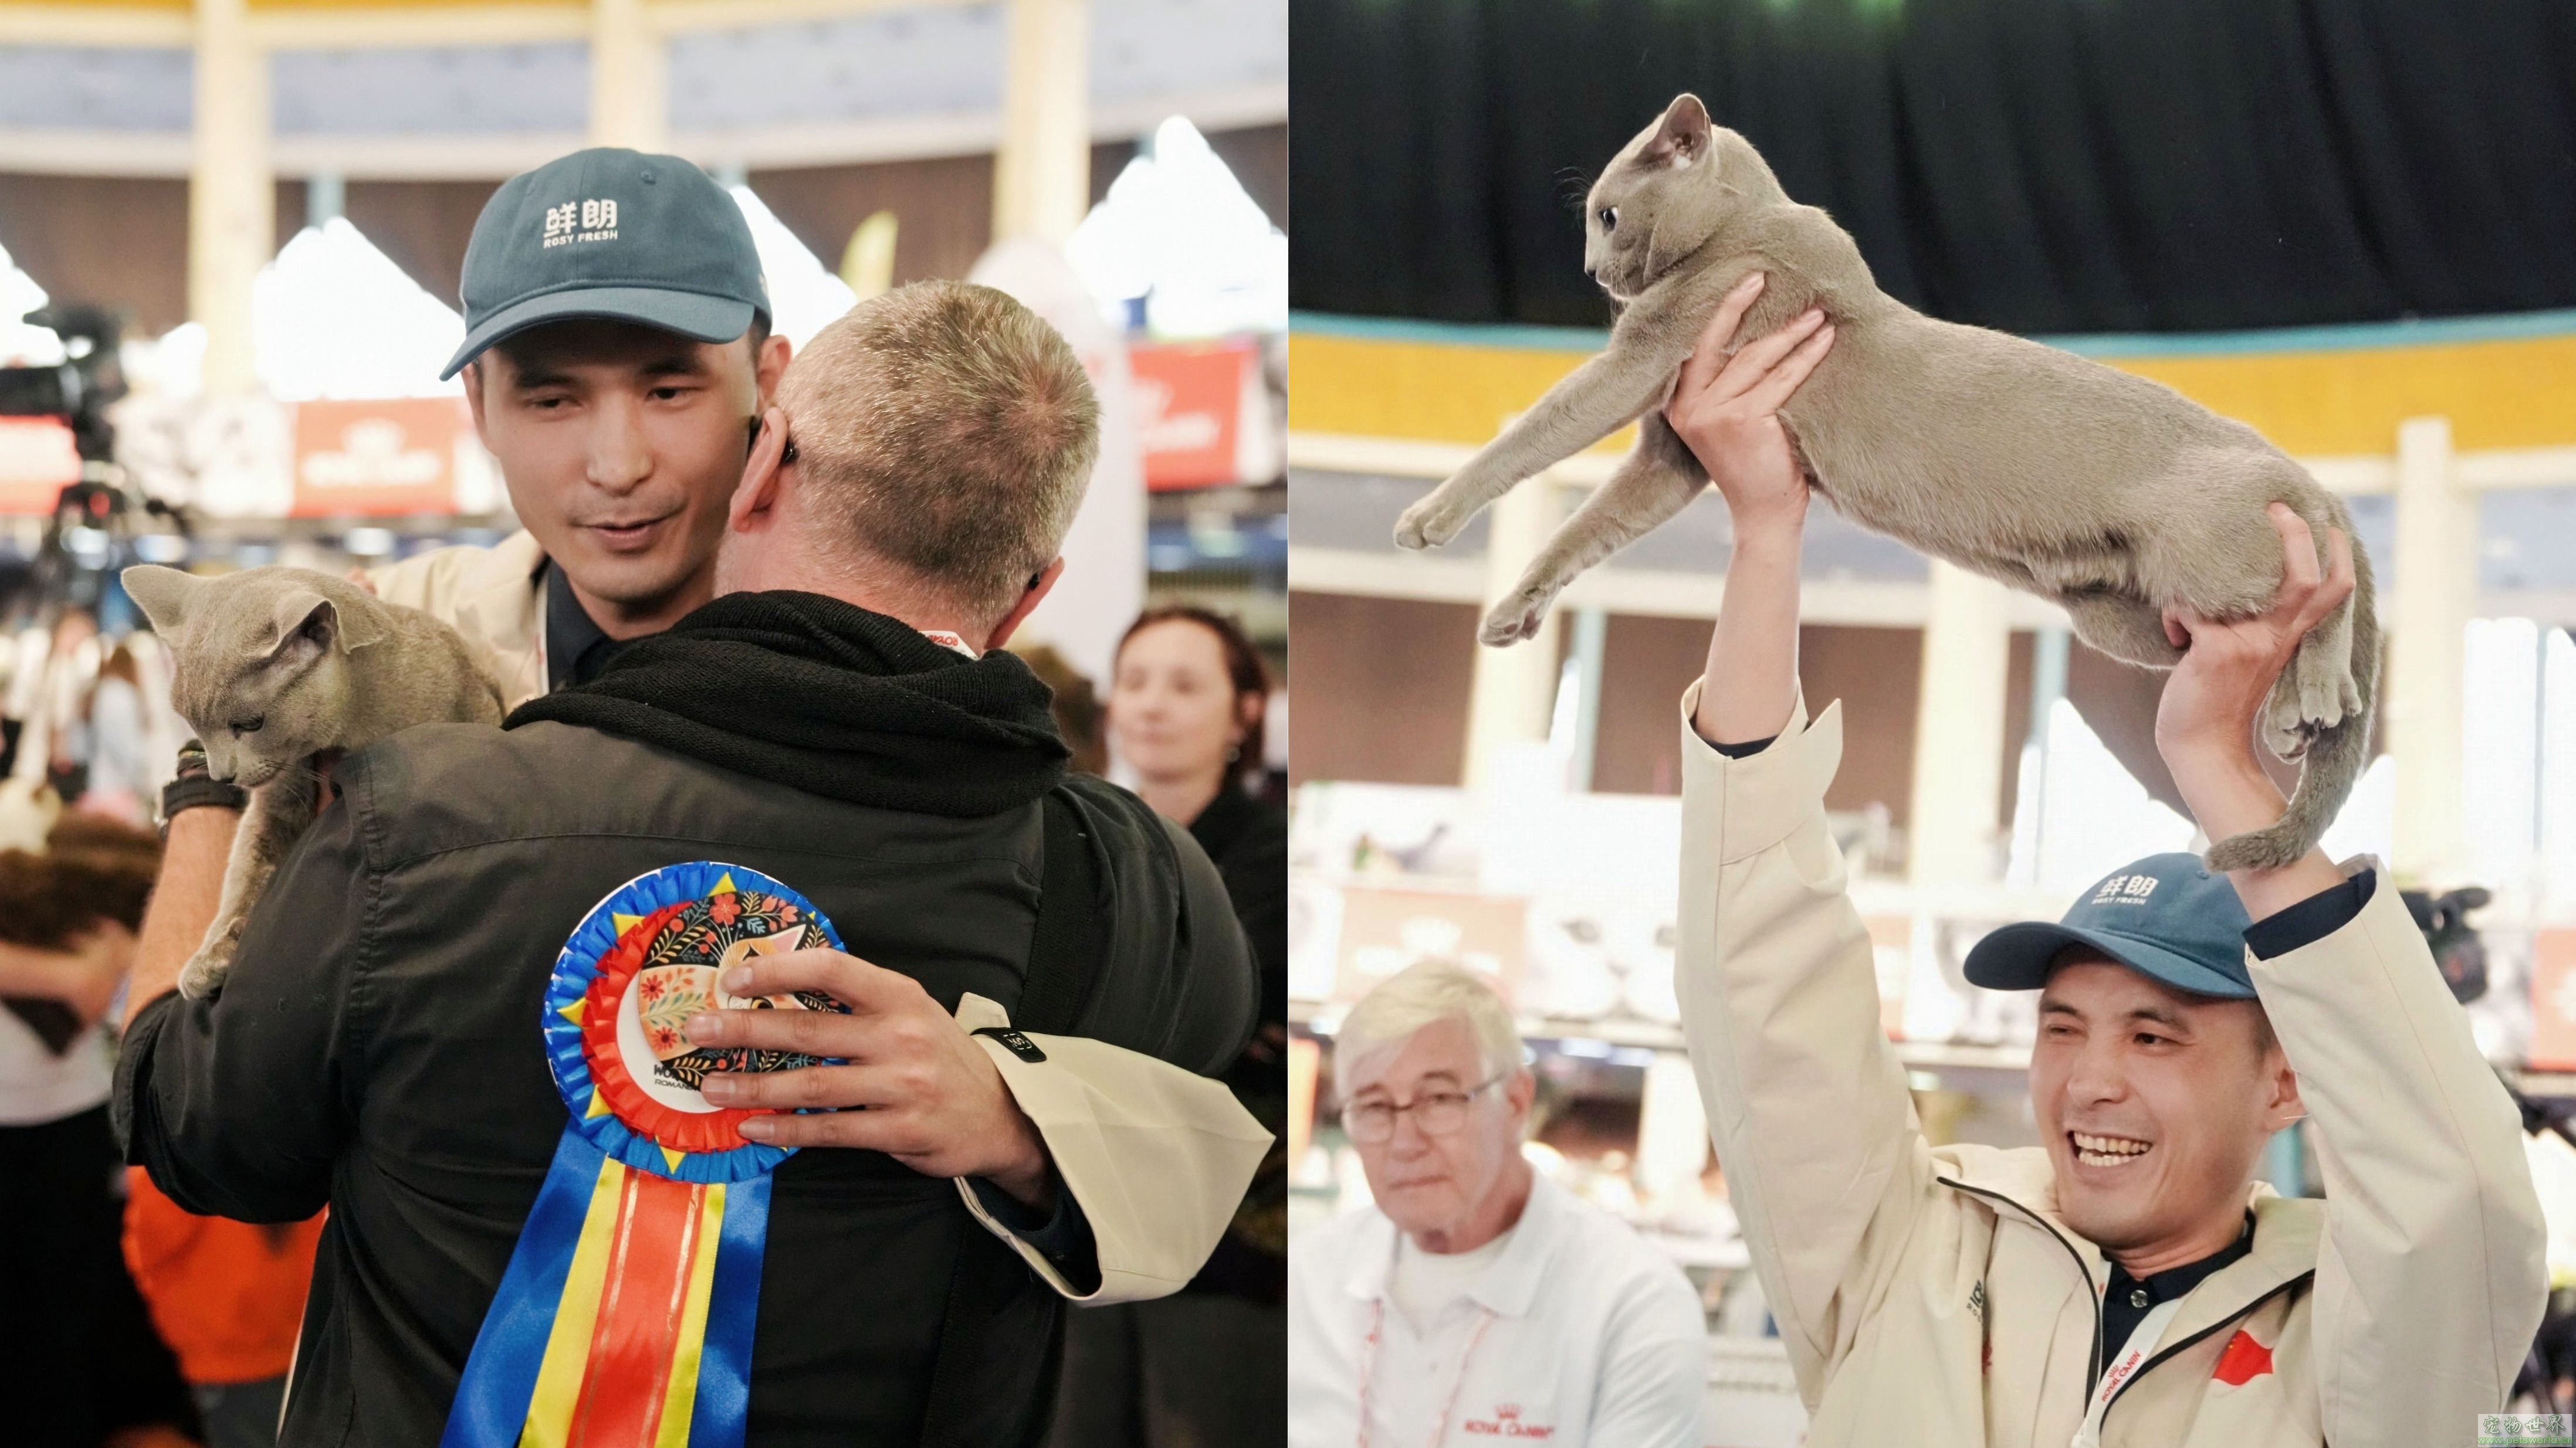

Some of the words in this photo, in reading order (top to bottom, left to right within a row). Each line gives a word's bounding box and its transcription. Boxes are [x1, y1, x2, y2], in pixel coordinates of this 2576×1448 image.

[543, 199, 618, 238] 鲜朗
[543, 233, 574, 249] ROSY
[577, 229, 618, 243] FRESH
[2095, 874, 2159, 897] 鲜朗
[2118, 1350, 2141, 1377] CANIN
